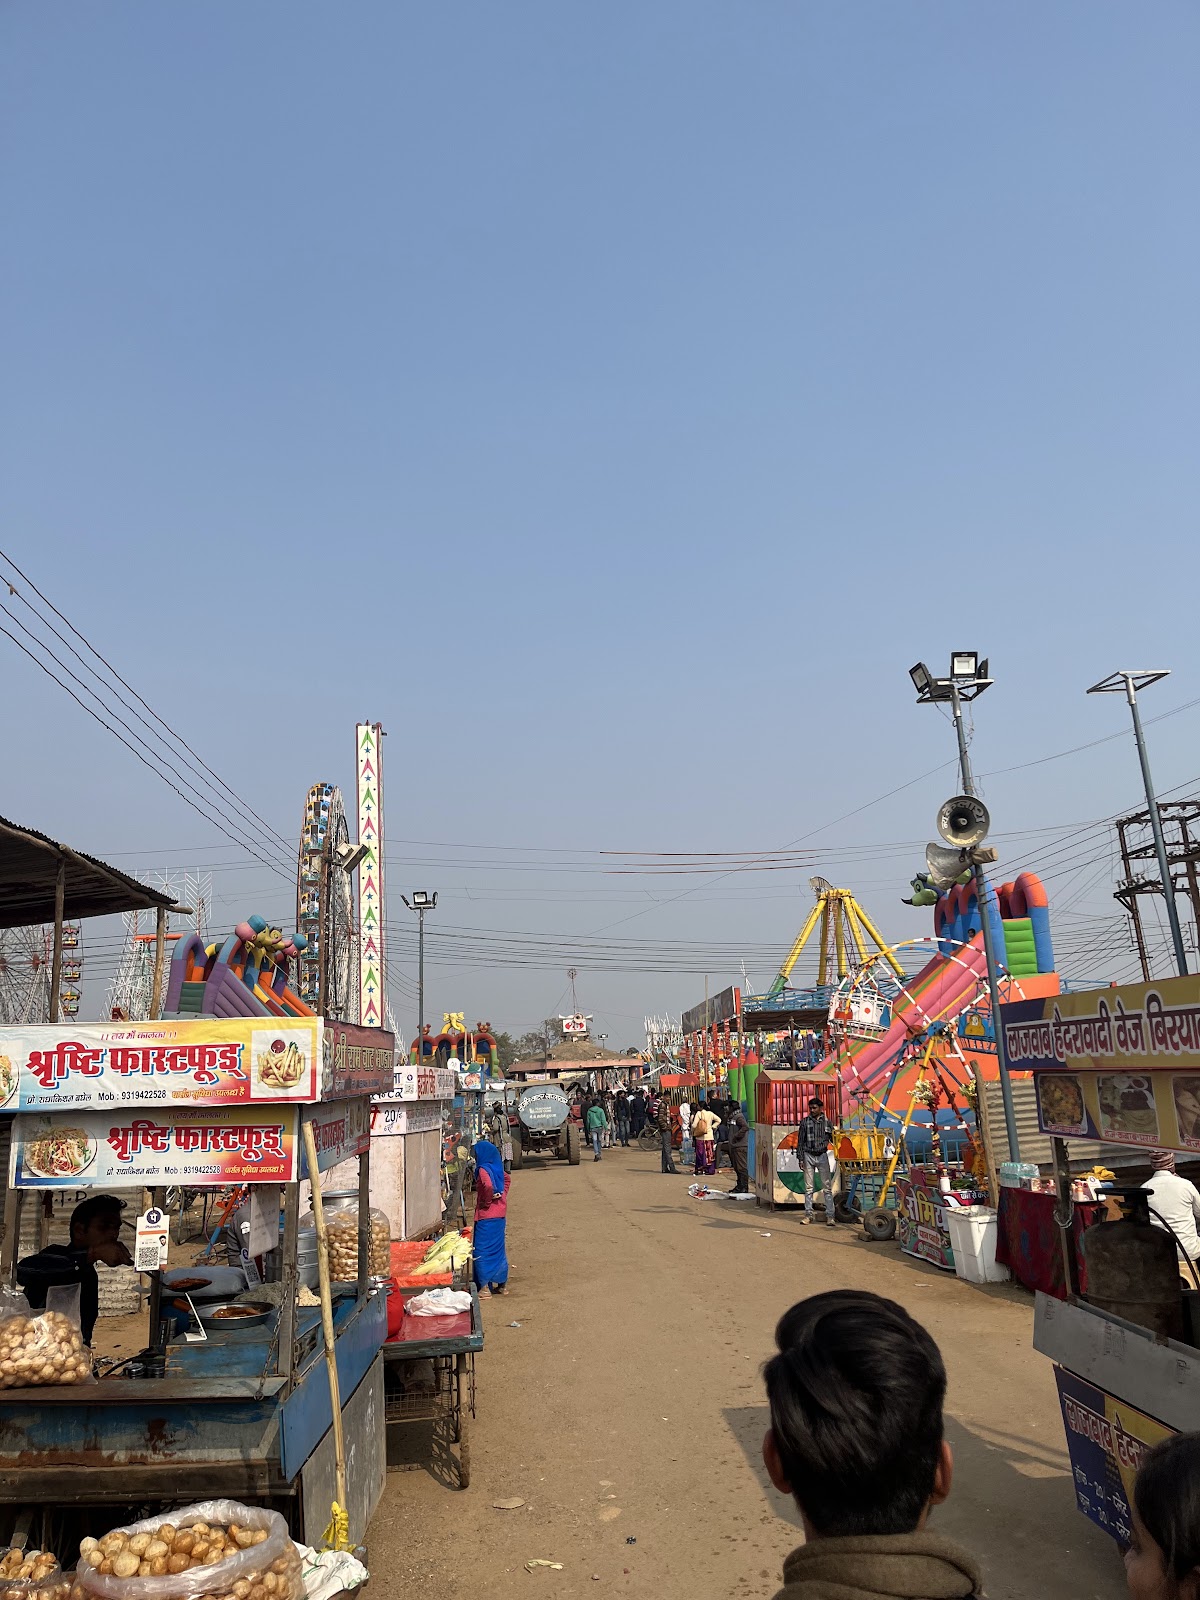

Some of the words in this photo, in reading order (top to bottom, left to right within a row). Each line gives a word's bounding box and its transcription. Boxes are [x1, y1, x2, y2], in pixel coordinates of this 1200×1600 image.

[137, 1031, 166, 1039] कालका
[1006, 1023, 1052, 1060] लाजवाब
[1115, 998, 1146, 1053] वेज
[335, 1032, 347, 1072] श्री
[347, 1046, 361, 1072] राम
[362, 1047, 374, 1072] चाट
[98, 1092, 115, 1101] Mob
[121, 1089, 167, 1100] 9319422528
[183, 1166, 220, 1174] 9319422528
[1064, 1394, 1115, 1456] लाजवाब
